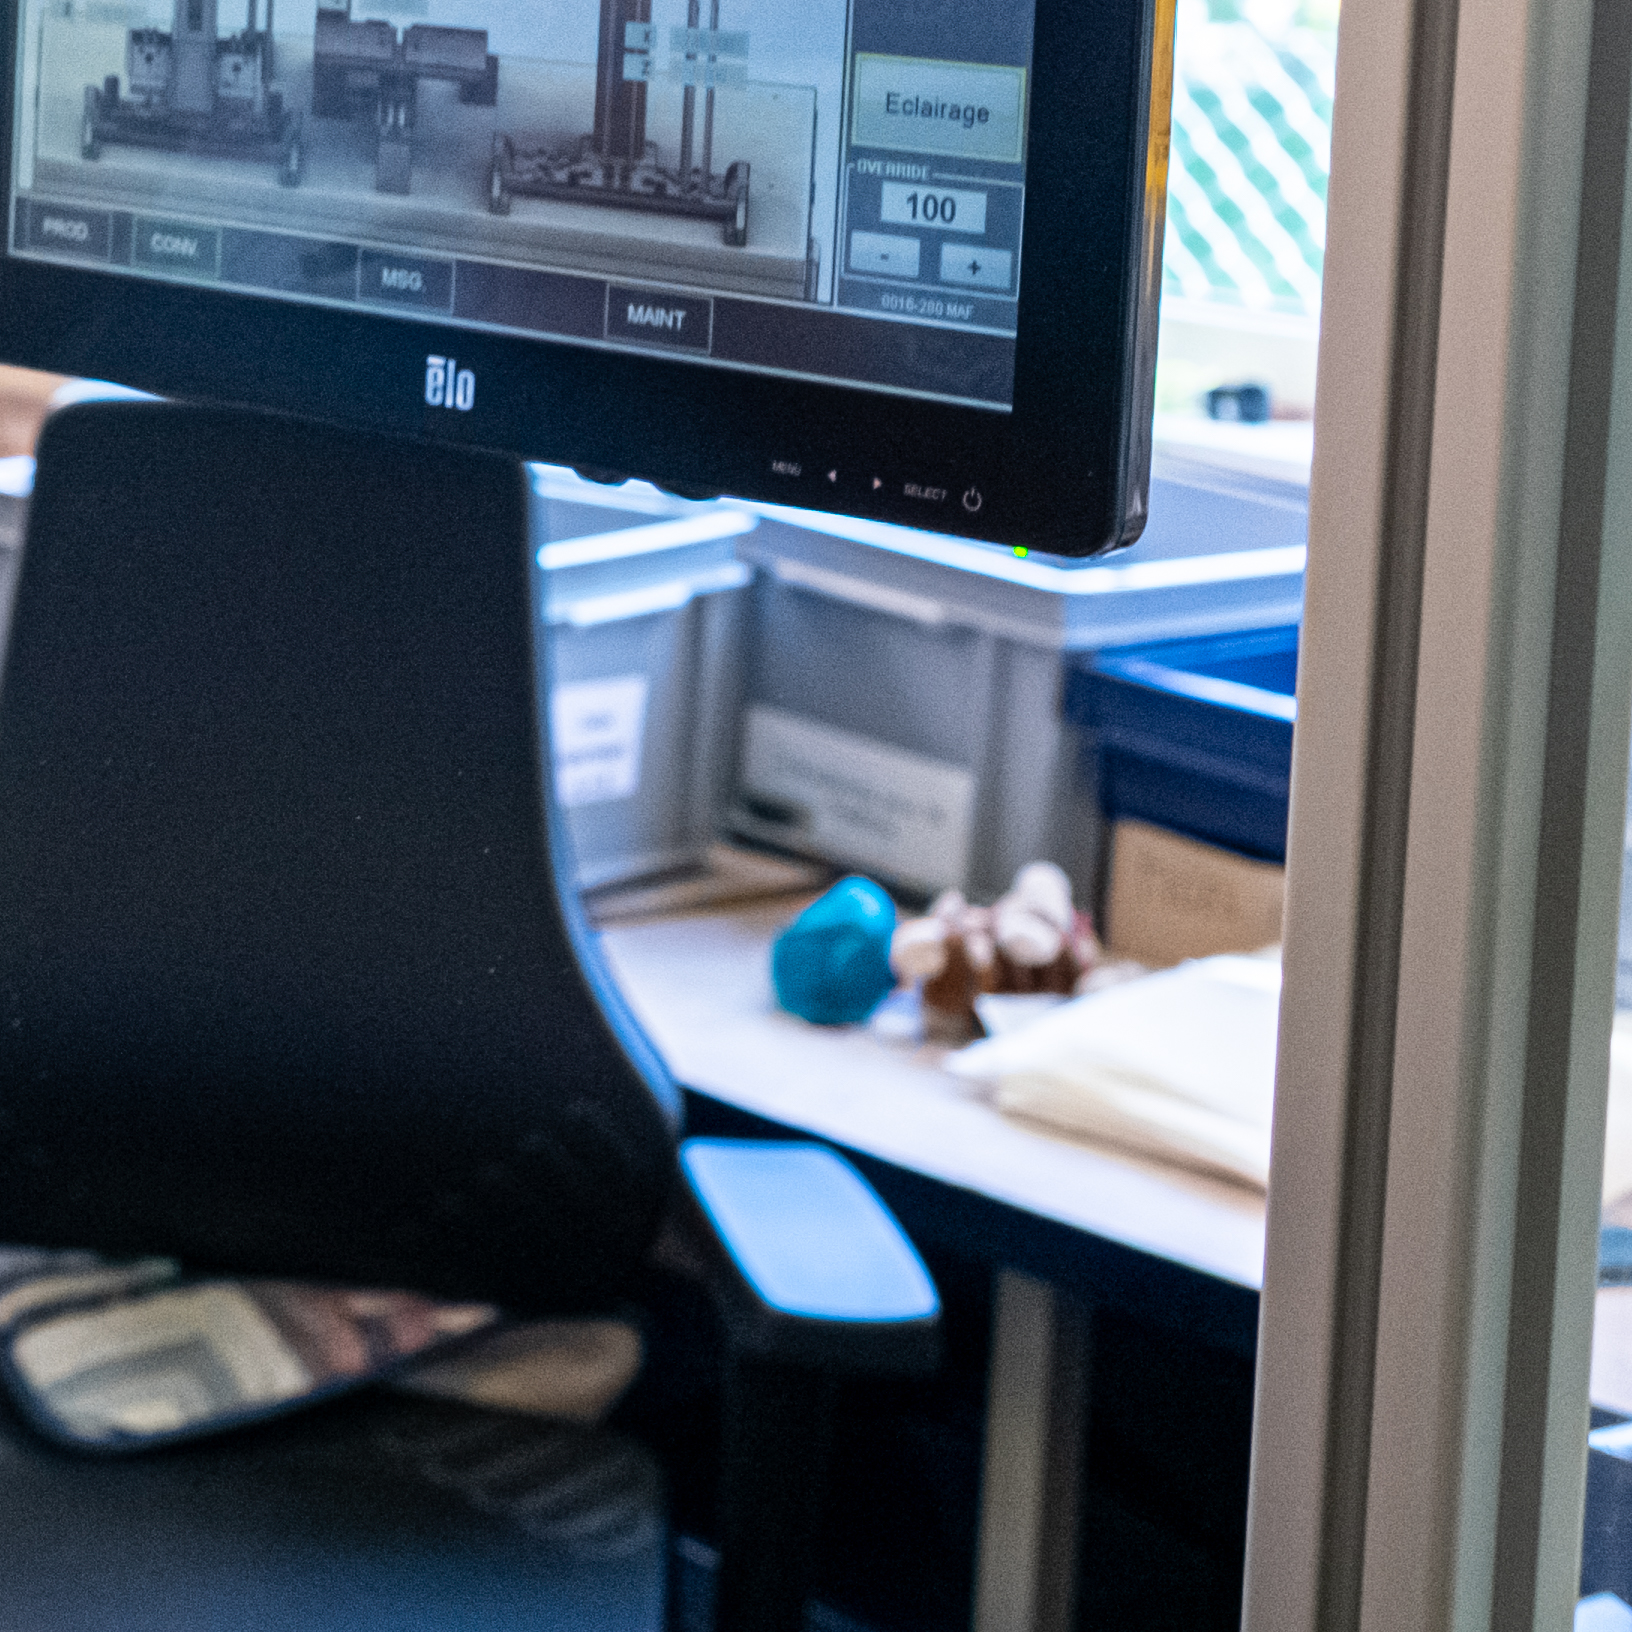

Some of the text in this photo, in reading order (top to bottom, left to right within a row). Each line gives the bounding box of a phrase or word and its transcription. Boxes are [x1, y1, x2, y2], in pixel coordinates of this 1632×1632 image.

[886, 92, 990, 129] Eclairage
[857, 158, 930, 182] OVERRIDE
[906, 191, 957, 224] 100
[627, 303, 686, 331] MAINT
[772, 459, 802, 477] MENU
[903, 483, 948, 501] SELECT
